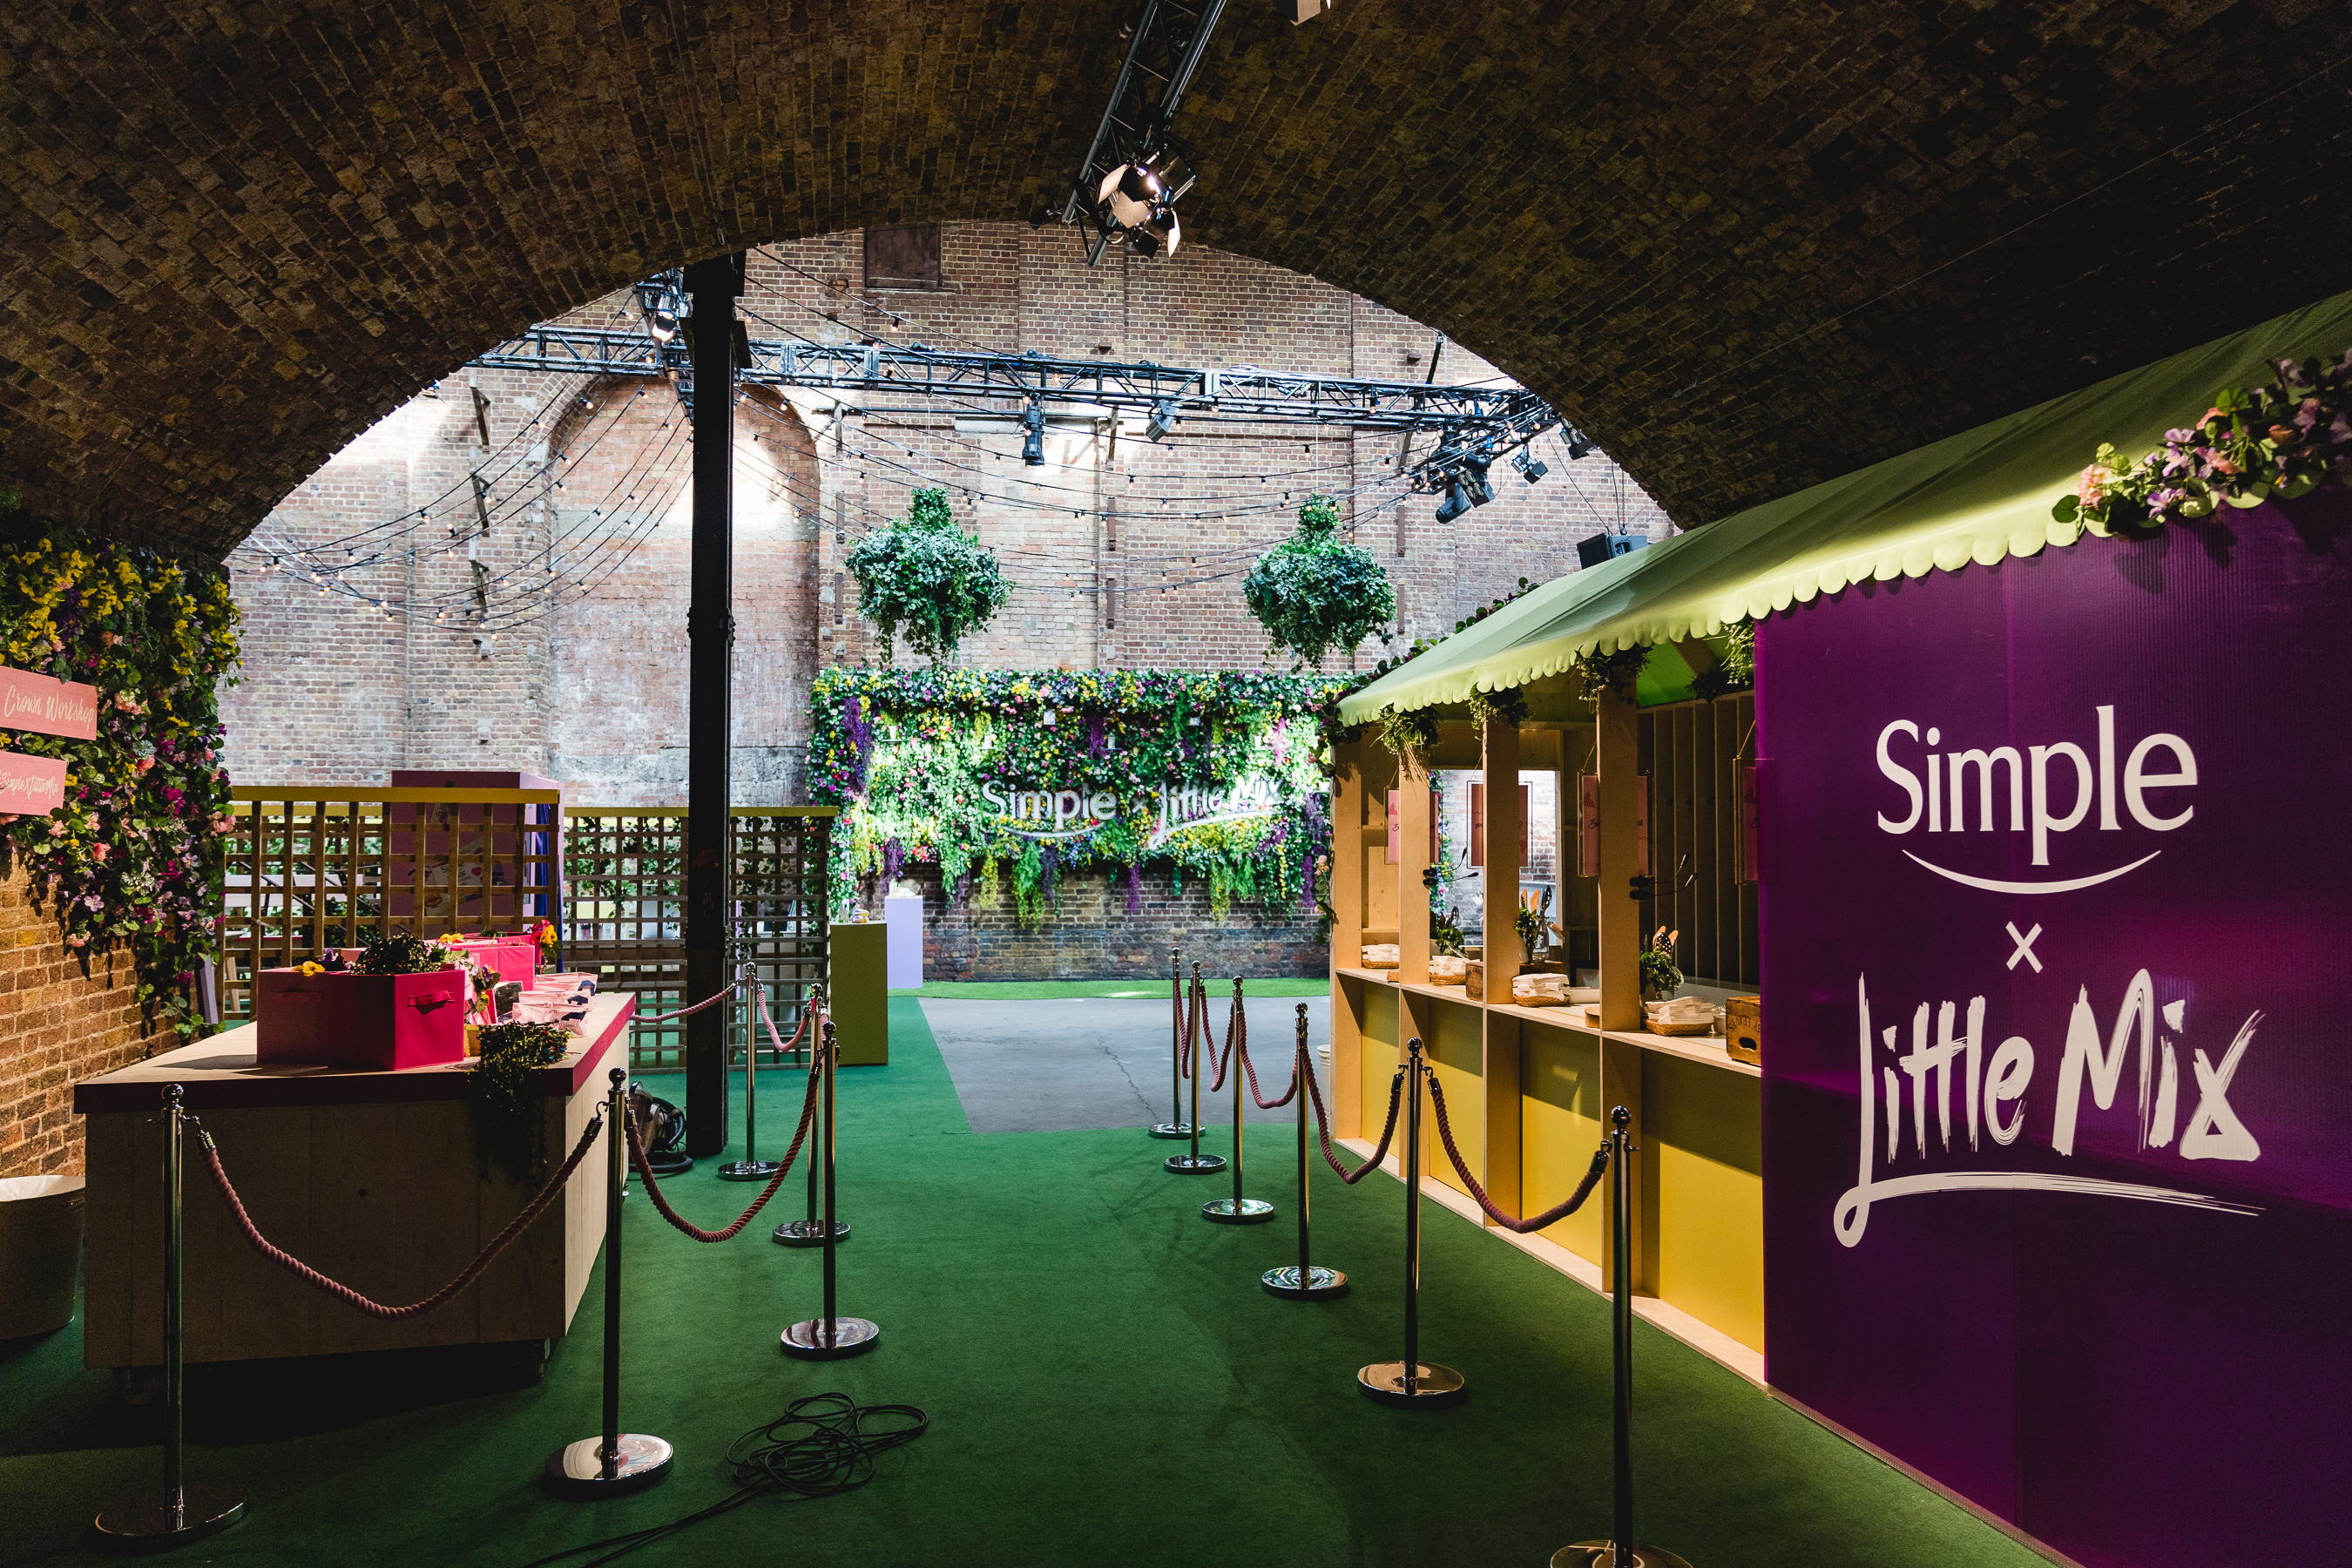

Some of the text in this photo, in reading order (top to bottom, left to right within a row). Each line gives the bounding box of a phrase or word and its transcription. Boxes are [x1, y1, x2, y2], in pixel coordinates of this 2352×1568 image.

[4, 685, 94, 732] Crown Workshop
[982, 780, 1118, 830] Simple
[1148, 780, 1225, 850] Little
[1230, 772, 1284, 811] Mix
[1876, 705, 2198, 866] Simple
[1834, 968, 2266, 1247] Little Mix
